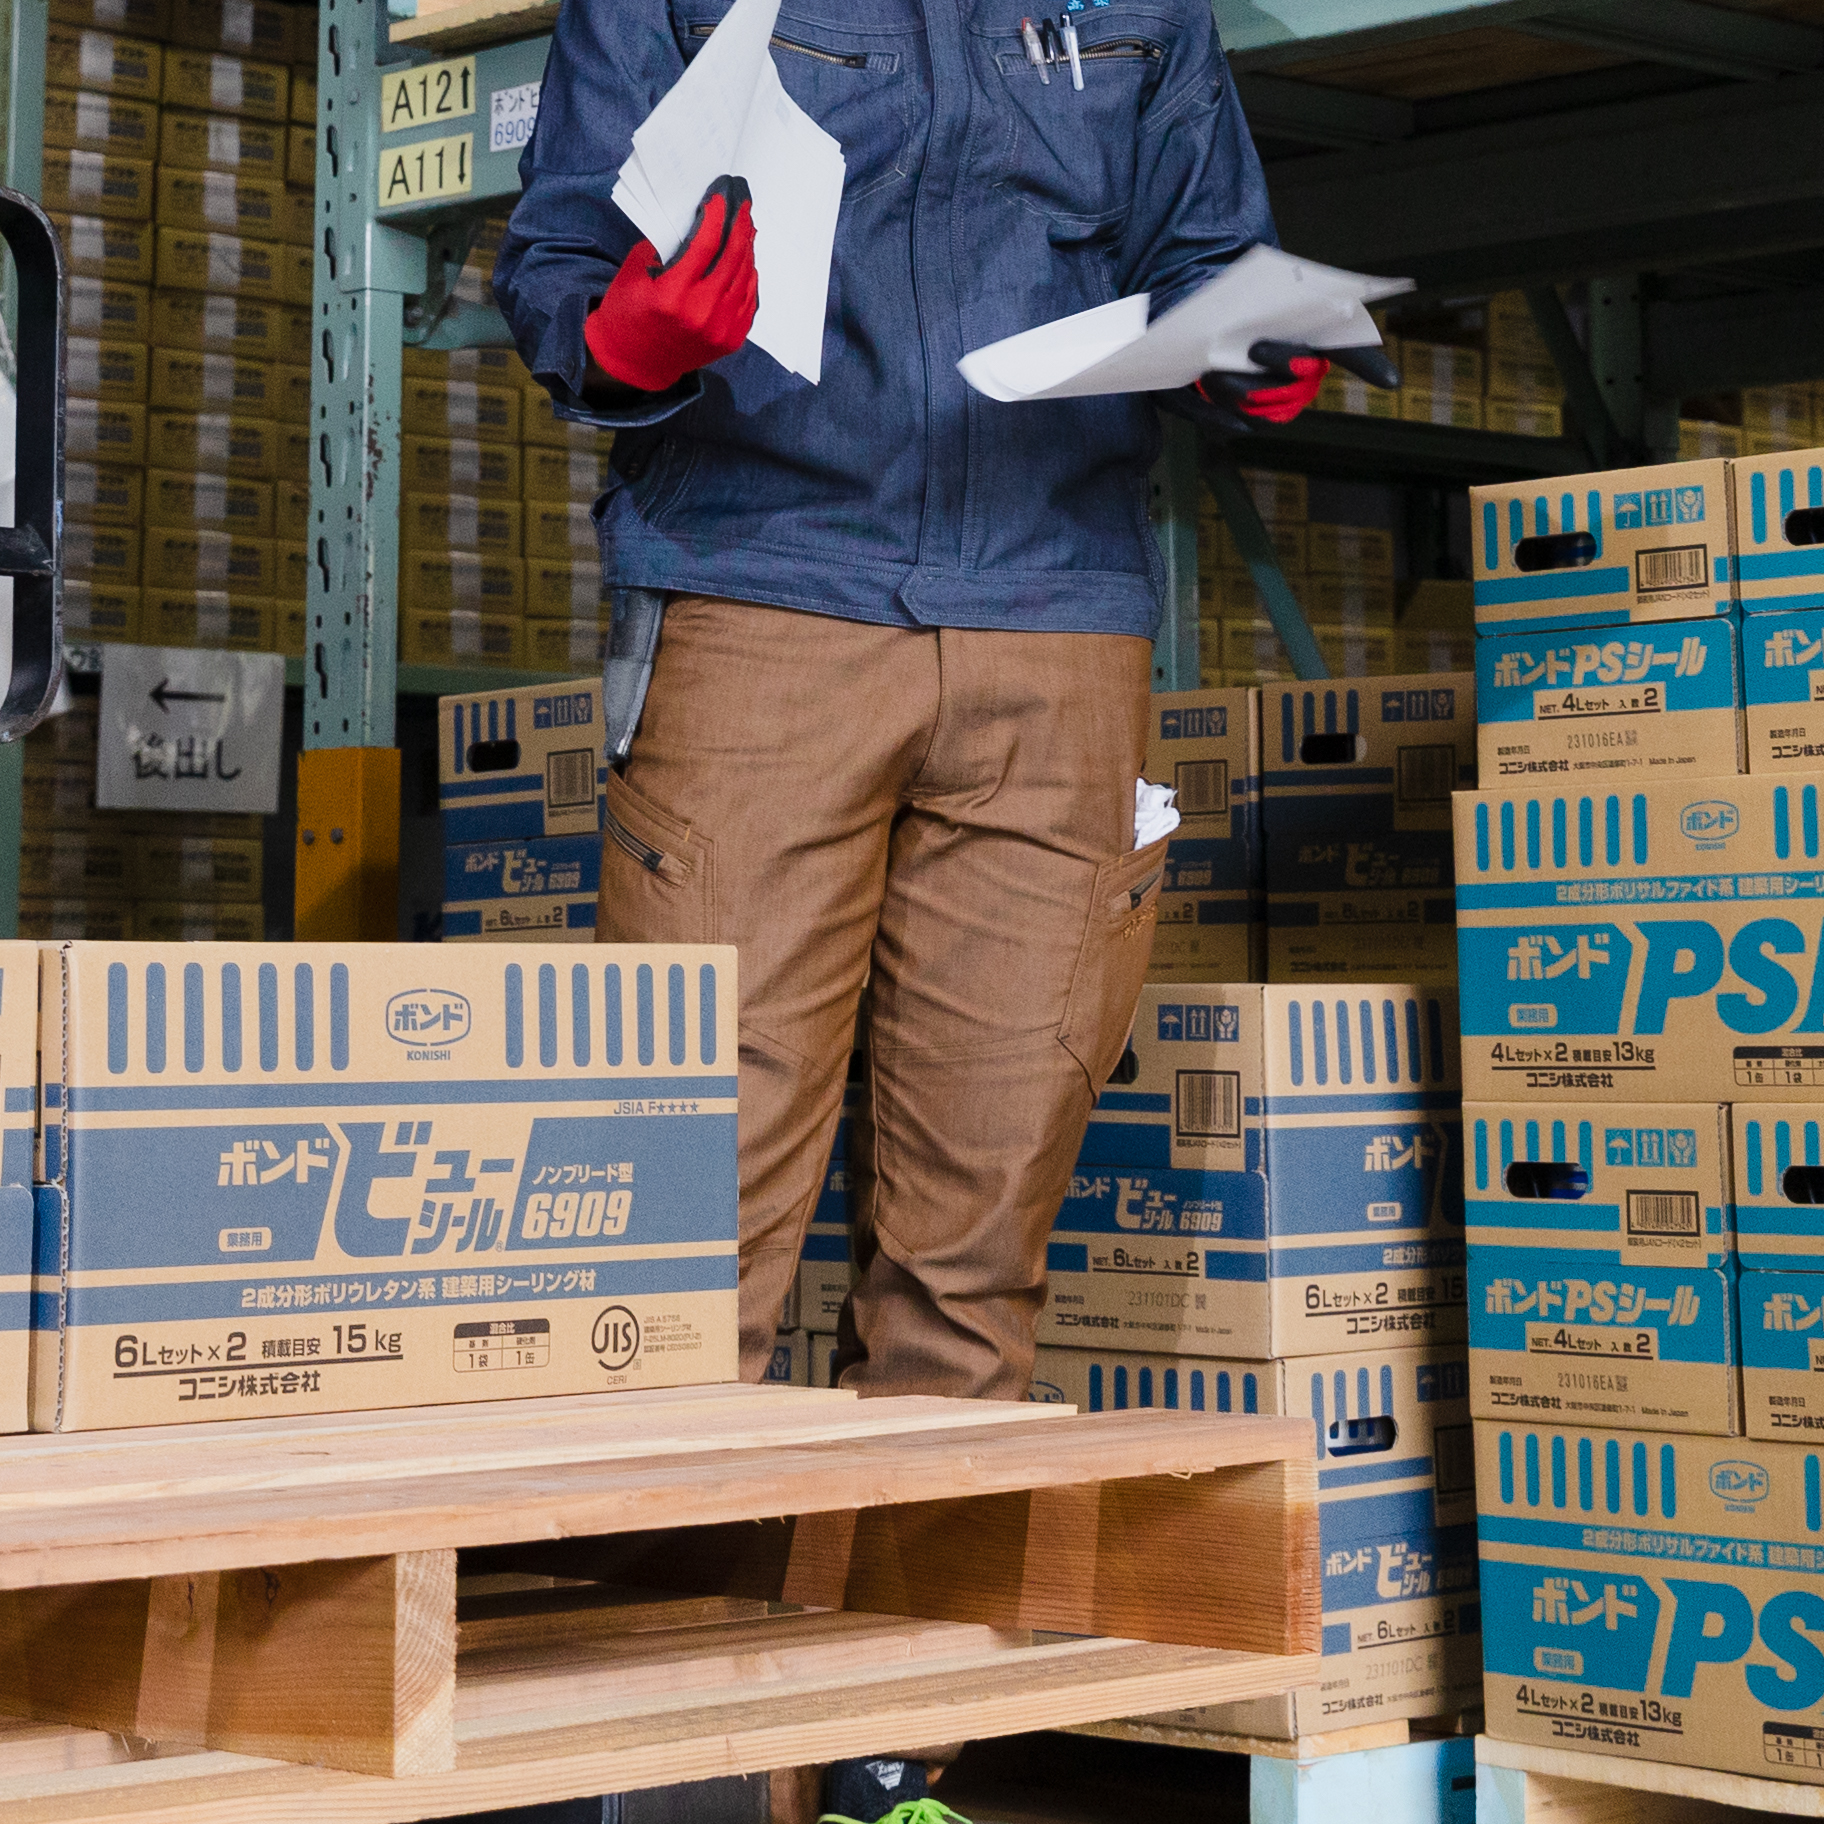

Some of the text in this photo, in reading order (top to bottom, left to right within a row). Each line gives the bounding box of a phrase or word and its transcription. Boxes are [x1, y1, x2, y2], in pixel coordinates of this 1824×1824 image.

[391, 70, 452, 123] A12
[388, 146, 444, 198] A11
[1507, 932, 1611, 982] ボンド
[1632, 916, 1809, 1035] PS
[393, 1003, 464, 1032] ボンド
[406, 1050, 451, 1061] KONISHI
[614, 1101, 645, 1115] JSIA
[217, 1139, 331, 1187] ボンド
[532, 1163, 634, 1185] ノンブリード型
[521, 1190, 634, 1240] 6909
[332, 1324, 367, 1354] 15
[374, 1328, 402, 1354] kg
[1346, 1311, 1436, 1335] コニシ株式会社
[178, 1370, 322, 1402] コニシ株式会社
[1530, 1578, 1638, 1634] ボンド
